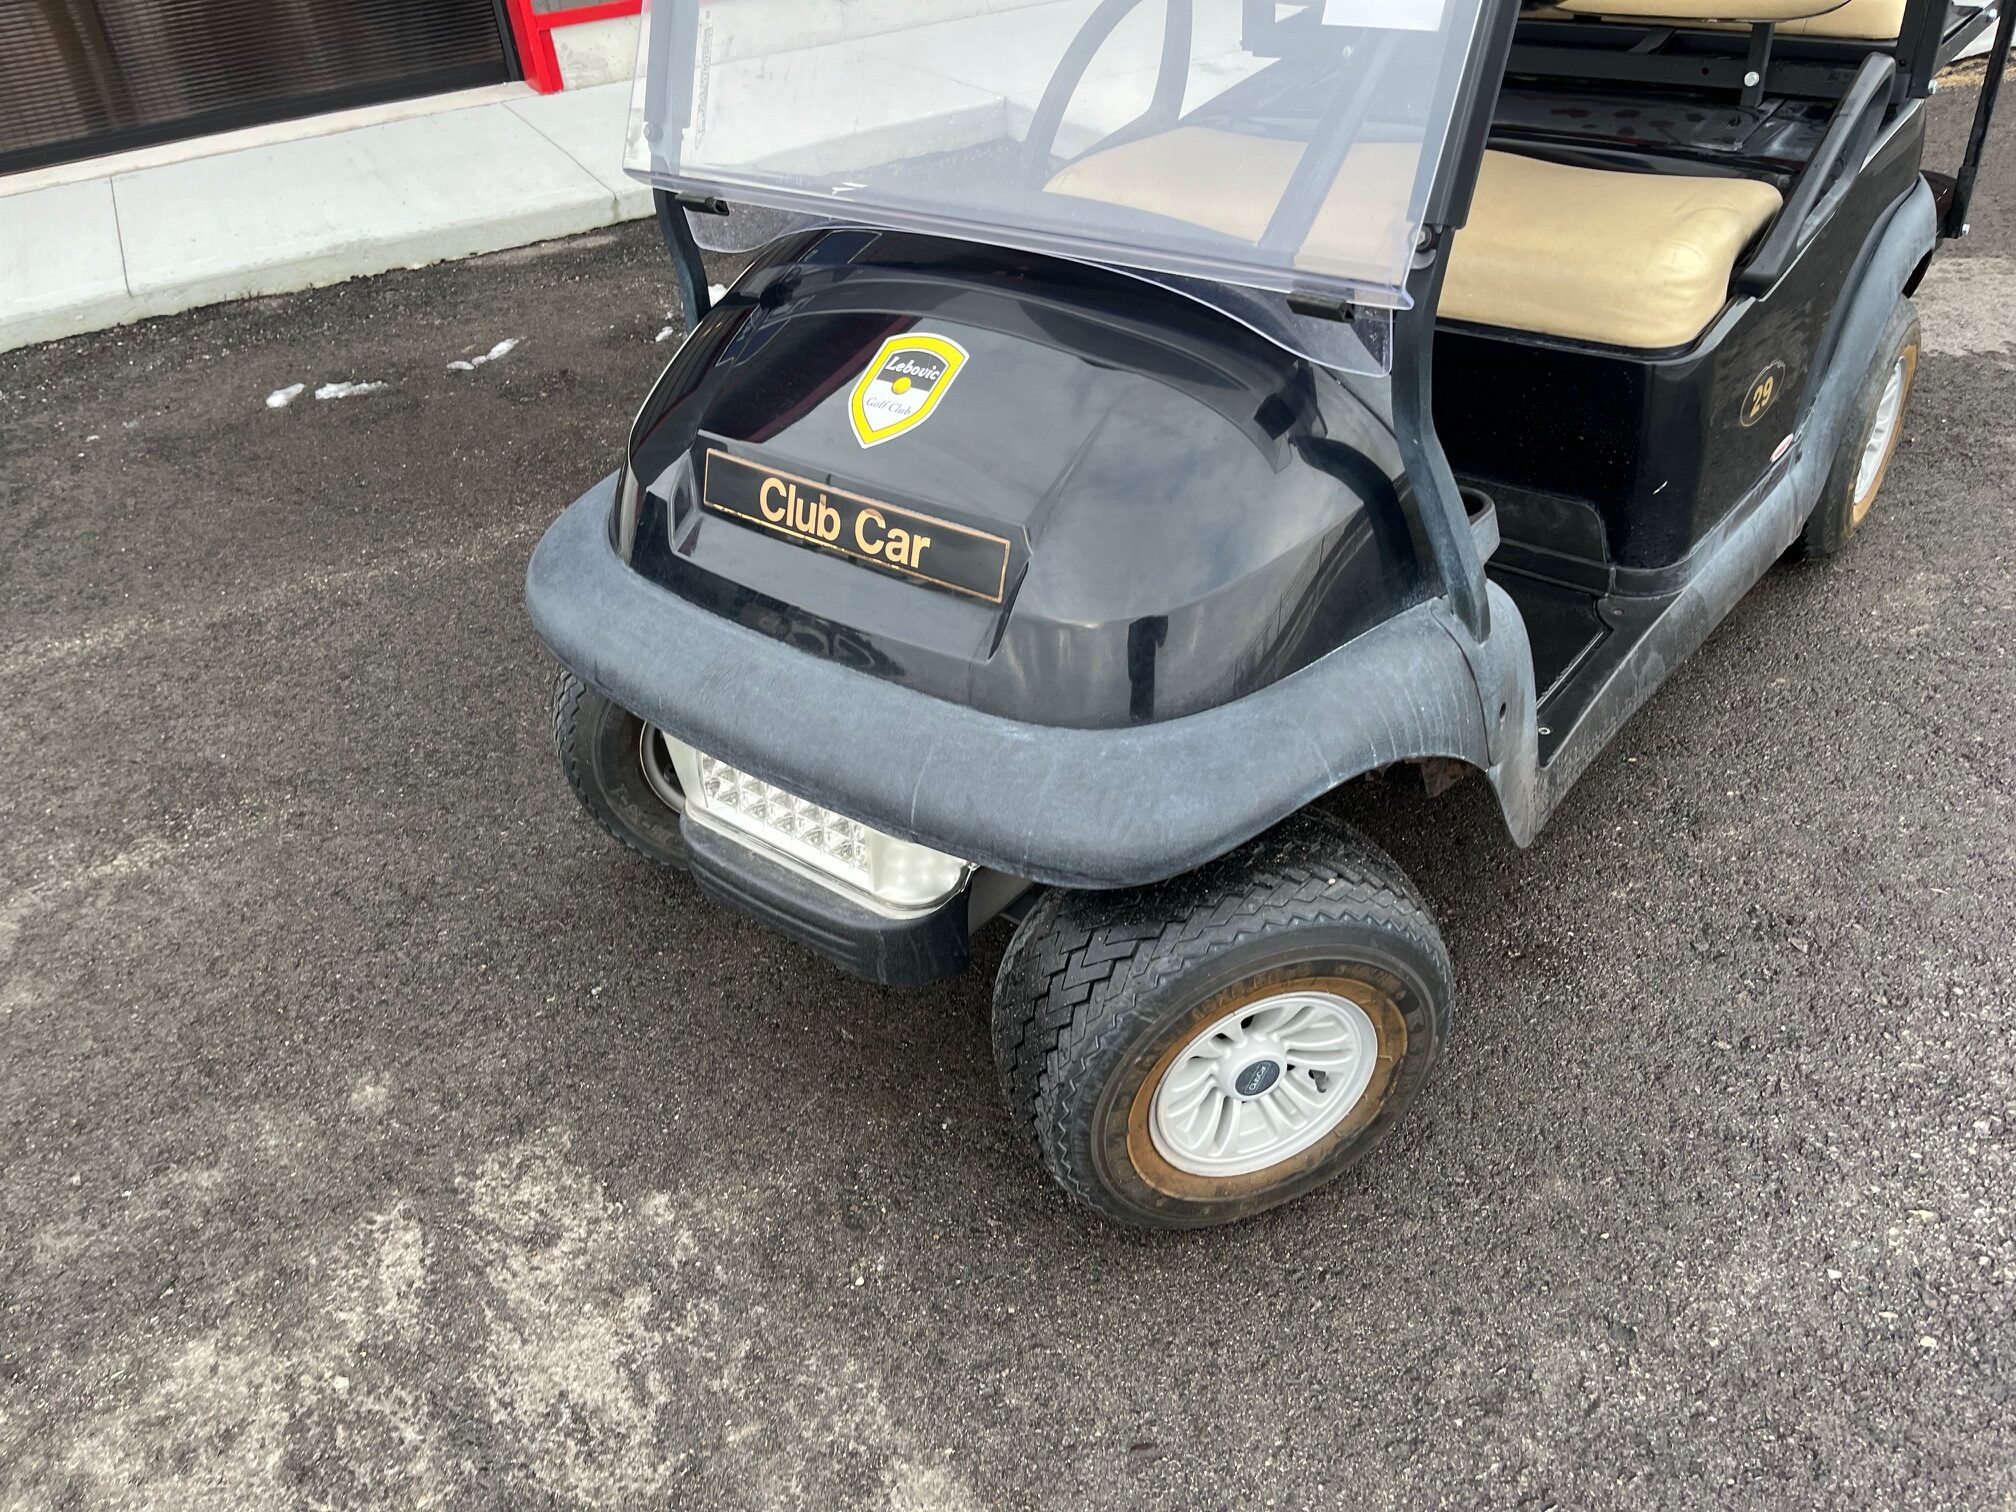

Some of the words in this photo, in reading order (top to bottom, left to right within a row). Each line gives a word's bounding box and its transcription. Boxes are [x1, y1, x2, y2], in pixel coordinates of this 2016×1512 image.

[885, 356, 940, 380] Lebovic
[866, 397, 890, 410] Golf
[888, 402, 912, 415] Club
[1749, 376, 1774, 418] 29
[759, 477, 841, 541] Club
[854, 508, 931, 569] Car
